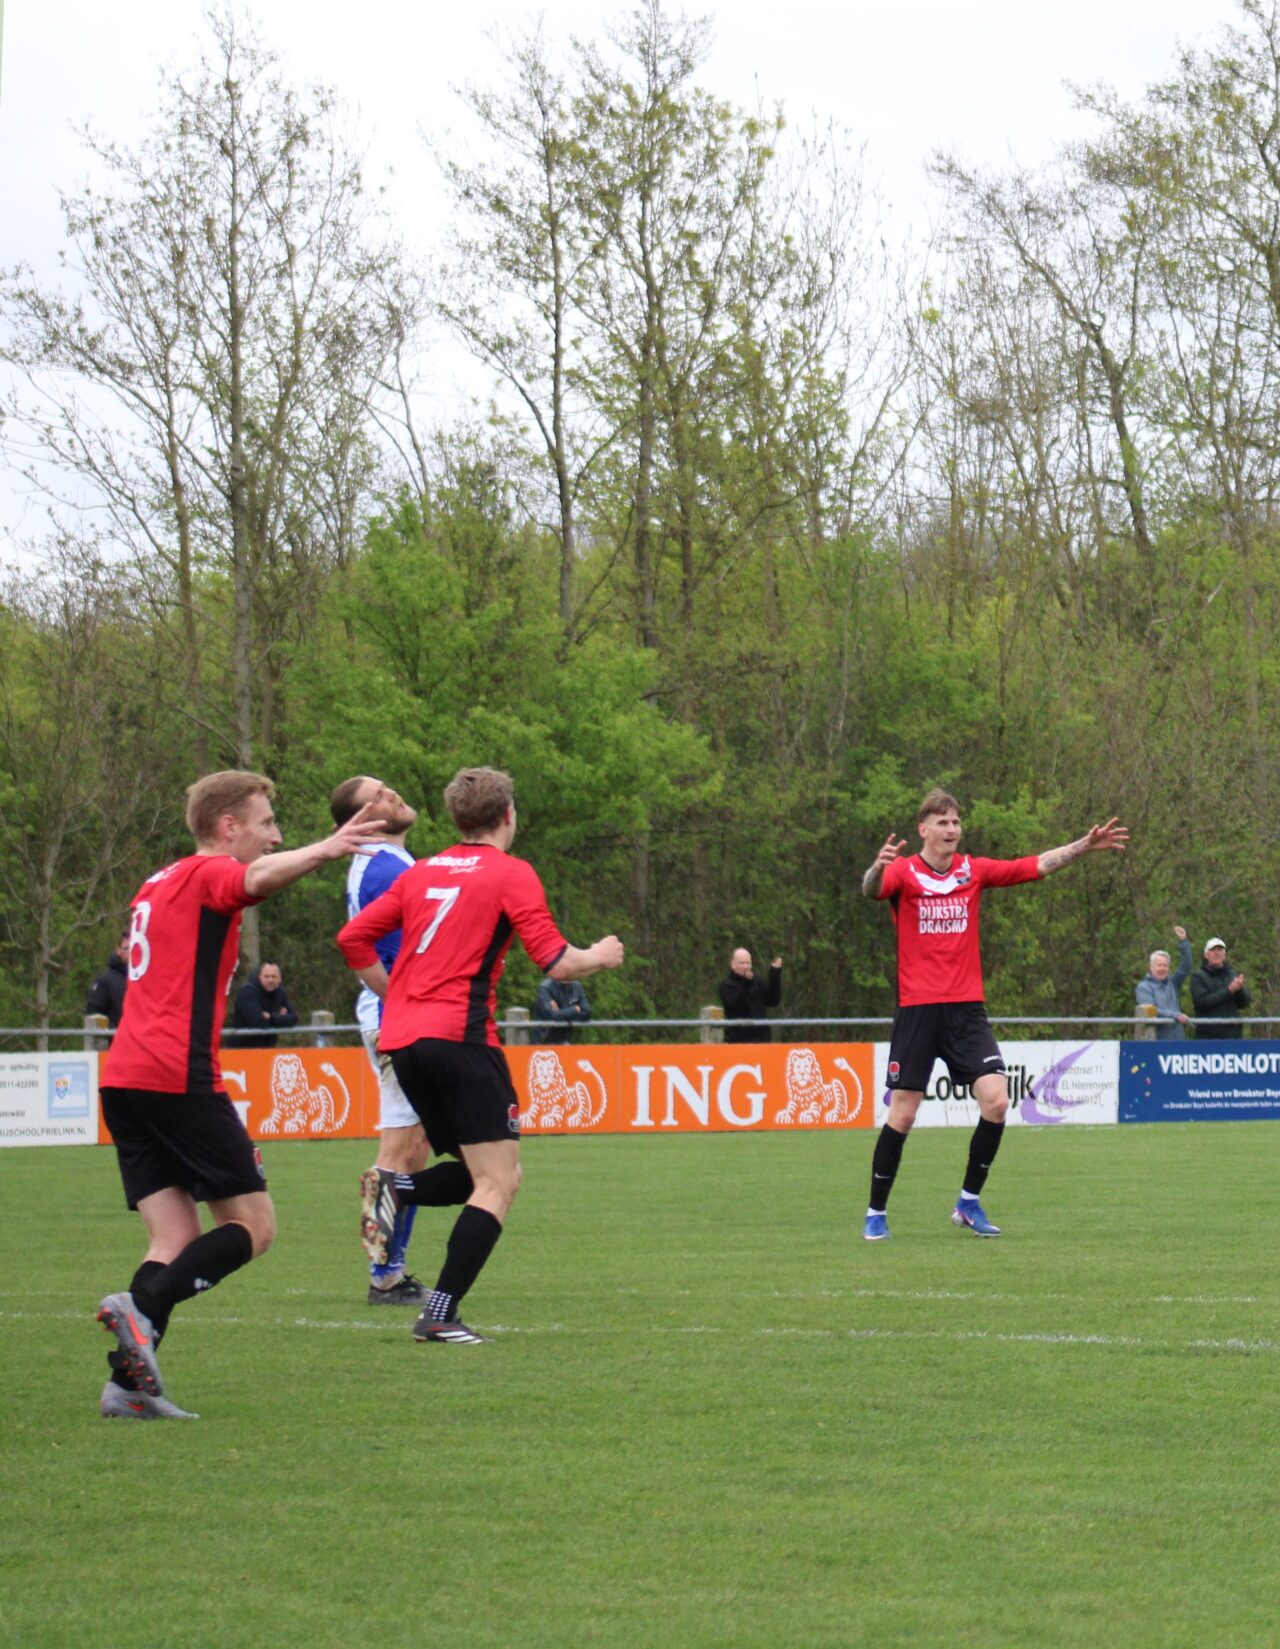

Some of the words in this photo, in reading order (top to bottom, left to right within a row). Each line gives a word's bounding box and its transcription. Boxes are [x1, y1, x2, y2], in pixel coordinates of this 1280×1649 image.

[415, 886, 461, 954] 7
[919, 904, 969, 920] DIJKSTRA
[919, 918, 968, 935] DRAISMA
[128, 900, 152, 981] 8
[630, 1063, 768, 1126] ING
[0, 1127, 87, 1137] IJSCHOOLFRIELINK.NL
